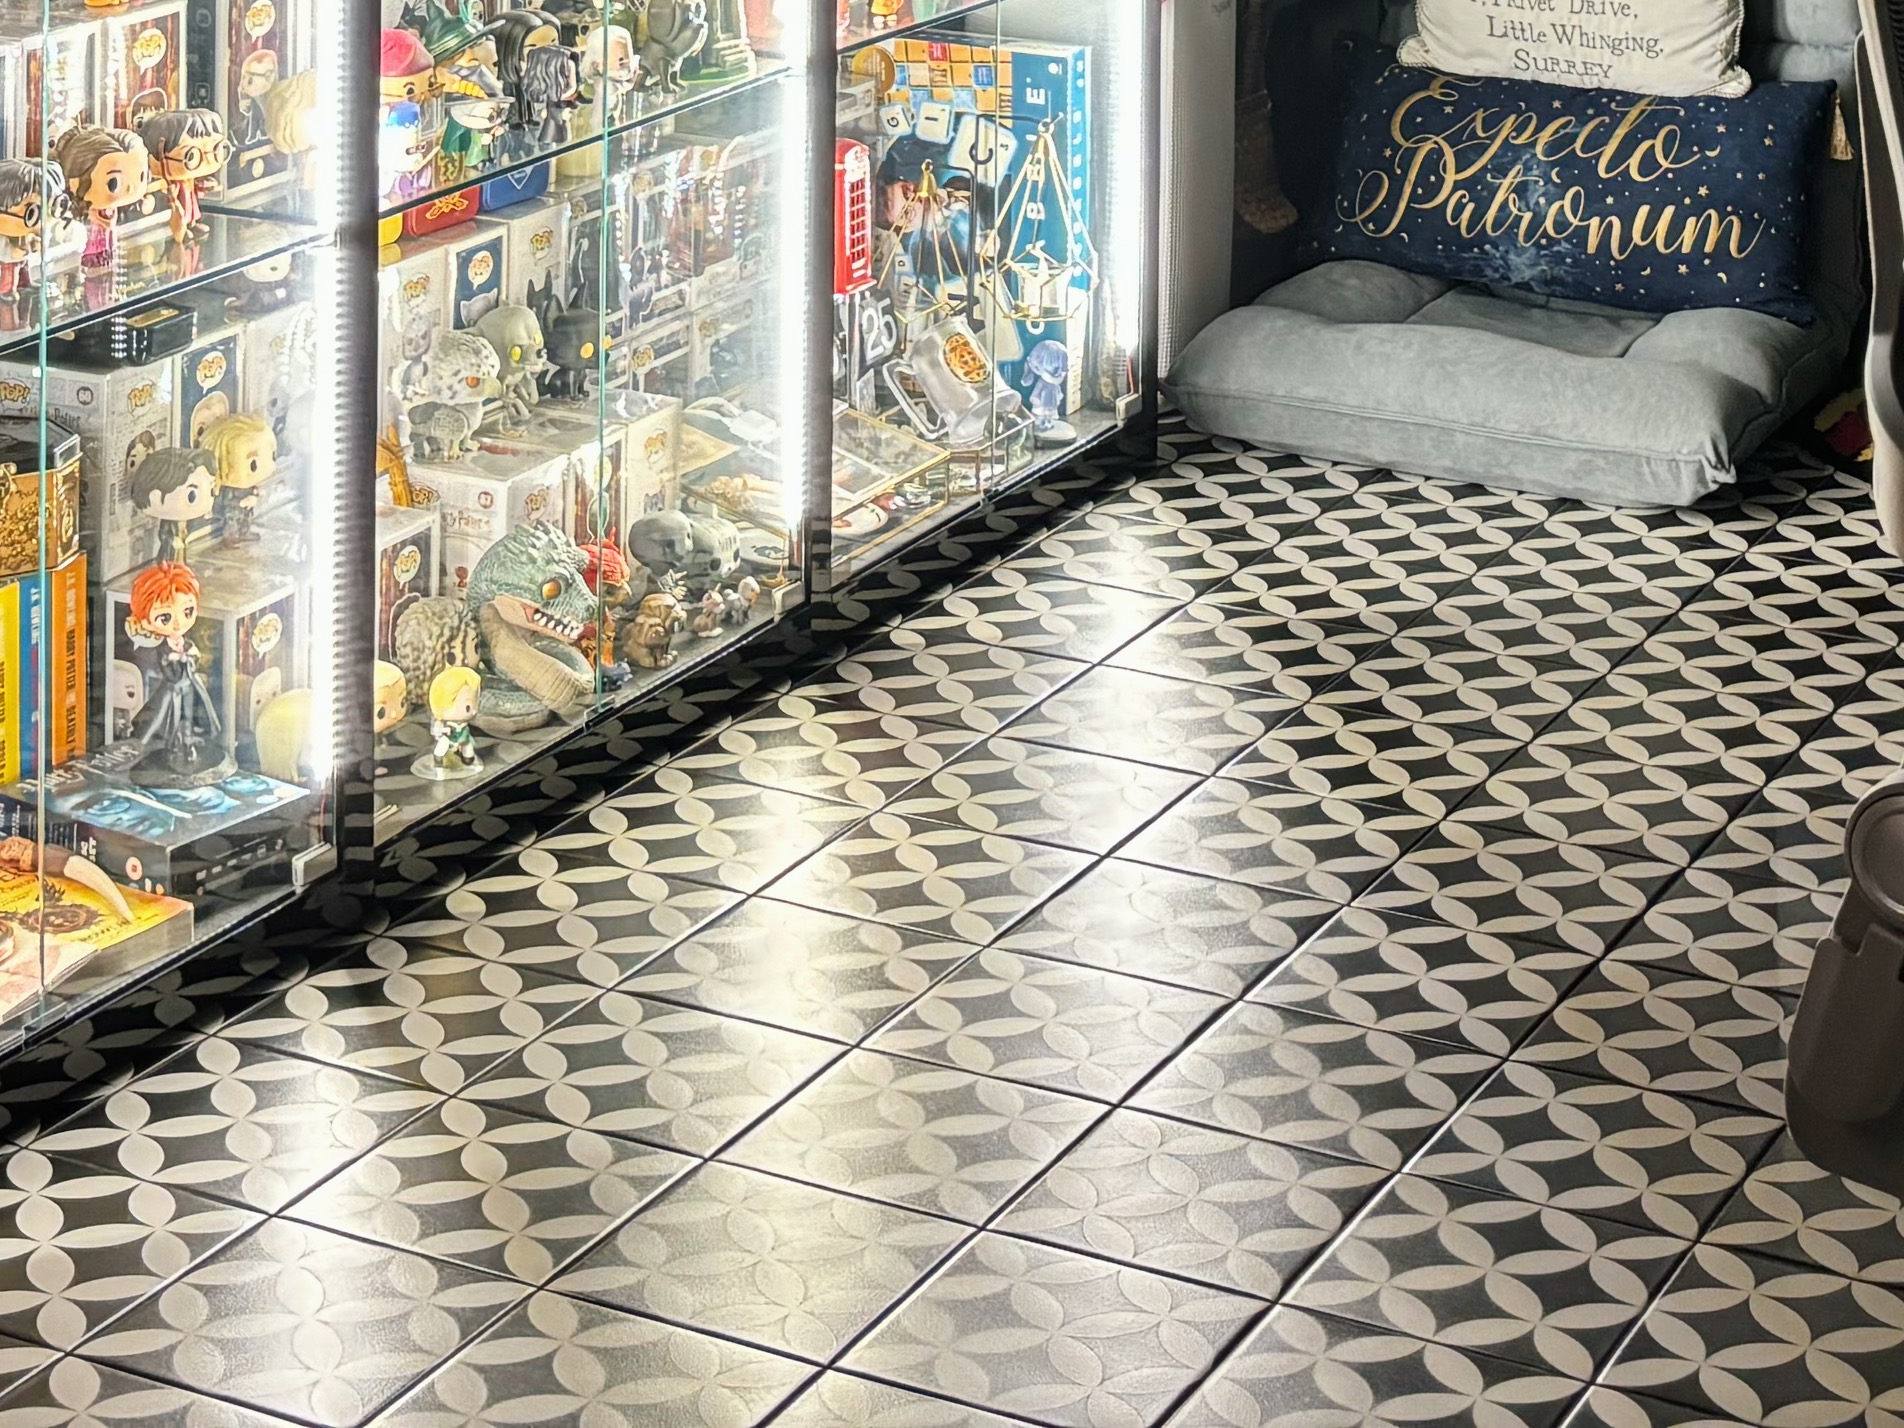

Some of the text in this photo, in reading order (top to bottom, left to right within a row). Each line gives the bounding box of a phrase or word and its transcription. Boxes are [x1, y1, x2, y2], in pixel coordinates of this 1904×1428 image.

[1484, 14, 1548, 44] Little
[1513, 47, 1614, 80] SURREY
[1388, 74, 1701, 182] Expecto
[1336, 134, 1767, 261] Patronum
[862, 298, 898, 358] 25
